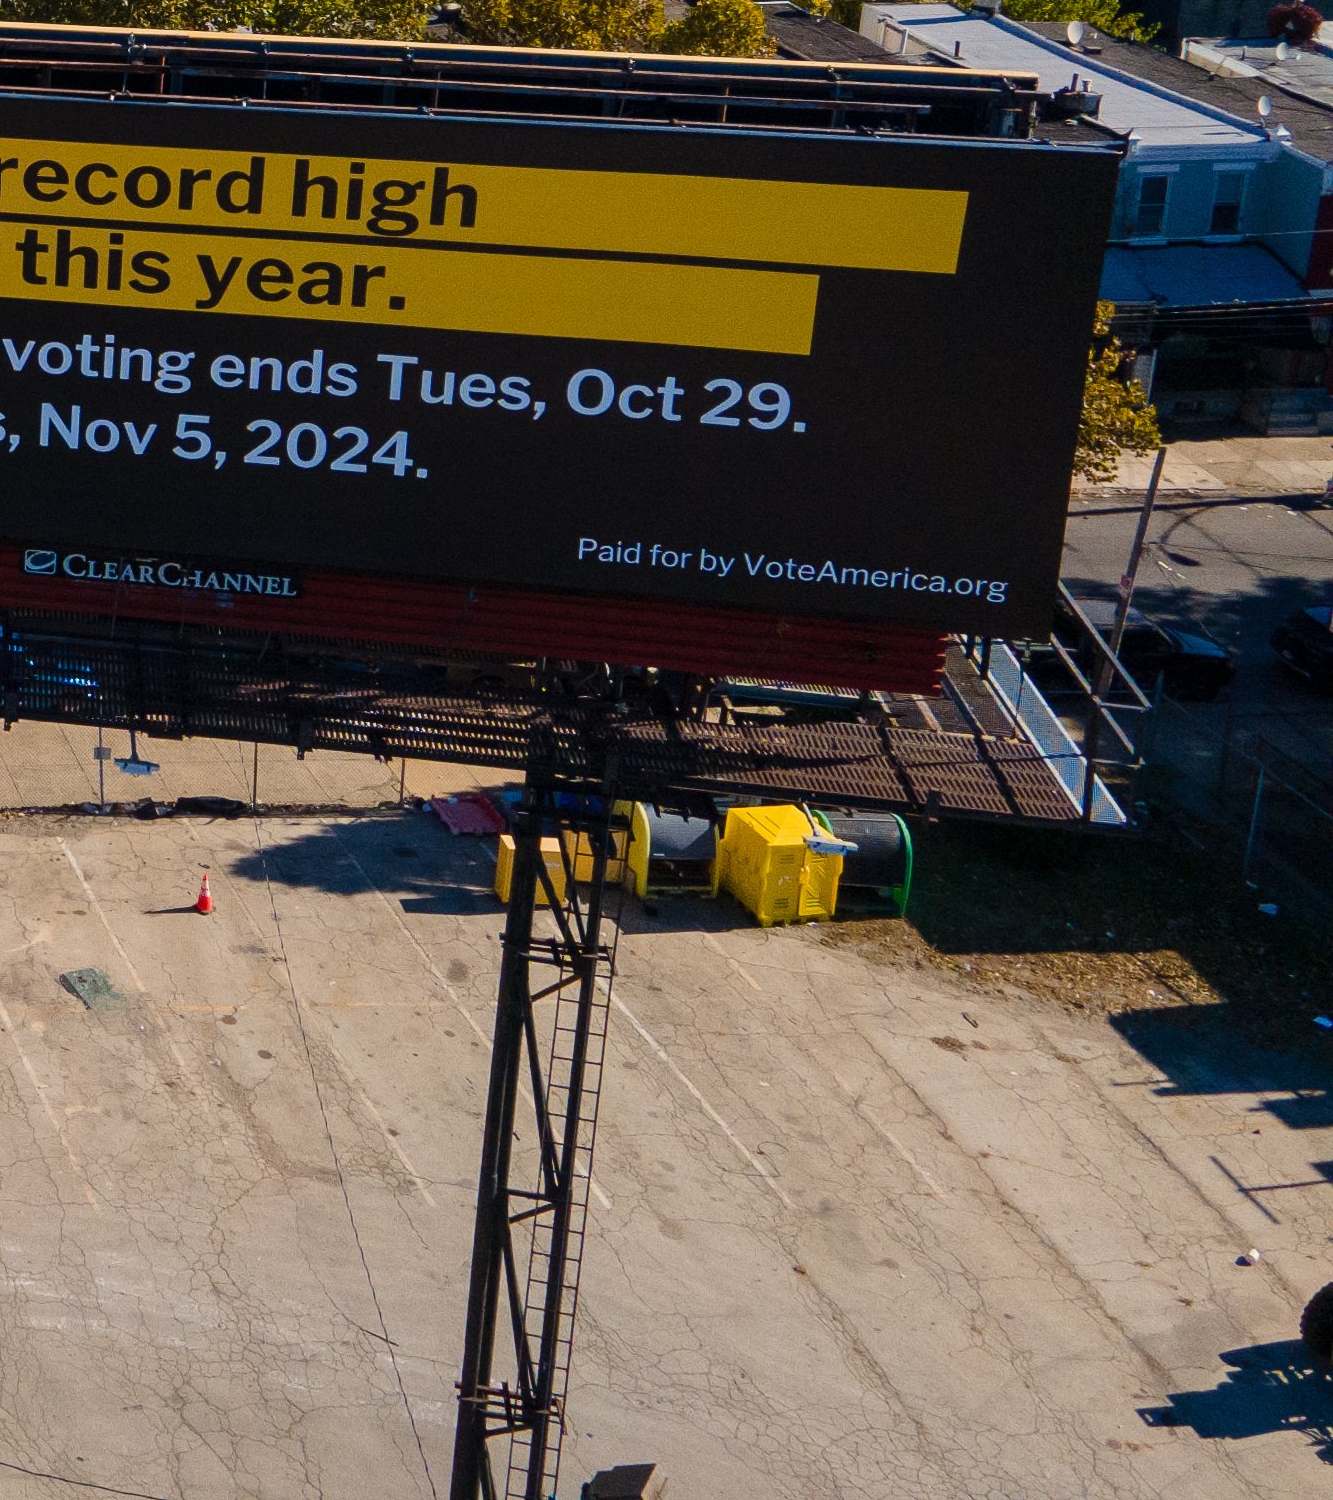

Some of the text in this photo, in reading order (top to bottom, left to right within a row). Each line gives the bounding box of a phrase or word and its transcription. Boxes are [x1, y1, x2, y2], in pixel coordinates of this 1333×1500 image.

[291, 158, 478, 237] high
[15, 228, 171, 295] this
[195, 254, 406, 311] year.
[2, 334, 196, 394] voting
[210, 349, 358, 397] ends
[376, 353, 546, 421] Tues,
[566, 368, 685, 422] Oct
[699, 378, 806, 433] 29.
[39, 402, 158, 455] Nov
[172, 413, 227, 470] 5,
[243, 419, 428, 479] 2024.
[577, 537, 1009, 603] Paid for by VoteAmerica.org
